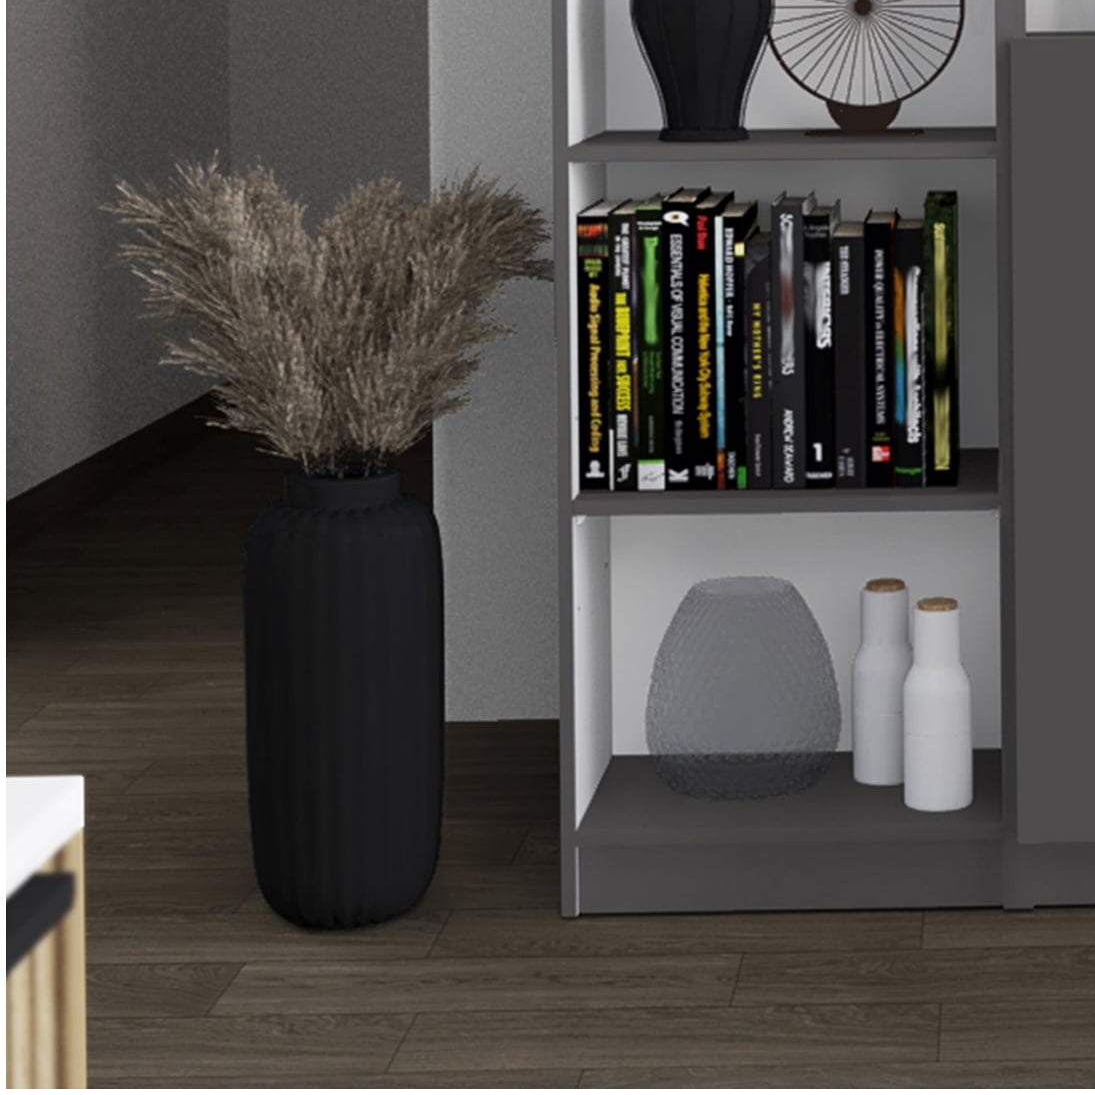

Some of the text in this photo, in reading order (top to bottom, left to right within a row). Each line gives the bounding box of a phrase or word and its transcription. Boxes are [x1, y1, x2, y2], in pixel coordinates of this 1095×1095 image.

[669, 233, 683, 290] ESSENTIALS
[725, 227, 735, 299] EDWARD HOPPER
[874, 249, 885, 279] POWER
[699, 274, 711, 306] Helvetica
[873, 281, 885, 321] QUALITY
[615, 306, 631, 357] BLUEPRINT
[670, 303, 684, 336] VISUAL
[699, 334, 711, 350] New
[699, 351, 712, 367] York
[753, 302, 763, 399] MY MOTHER'S RING
[875, 330, 887, 382] ELECTRICAL
[587, 283, 603, 453] Audio Signal Processing and Coding
[670, 337, 684, 414] COMMUNICATION
[616, 374, 632, 412] SUCCESS
[875, 382, 887, 425] SYSTEMS
[782, 408, 795, 443] ANDREW
